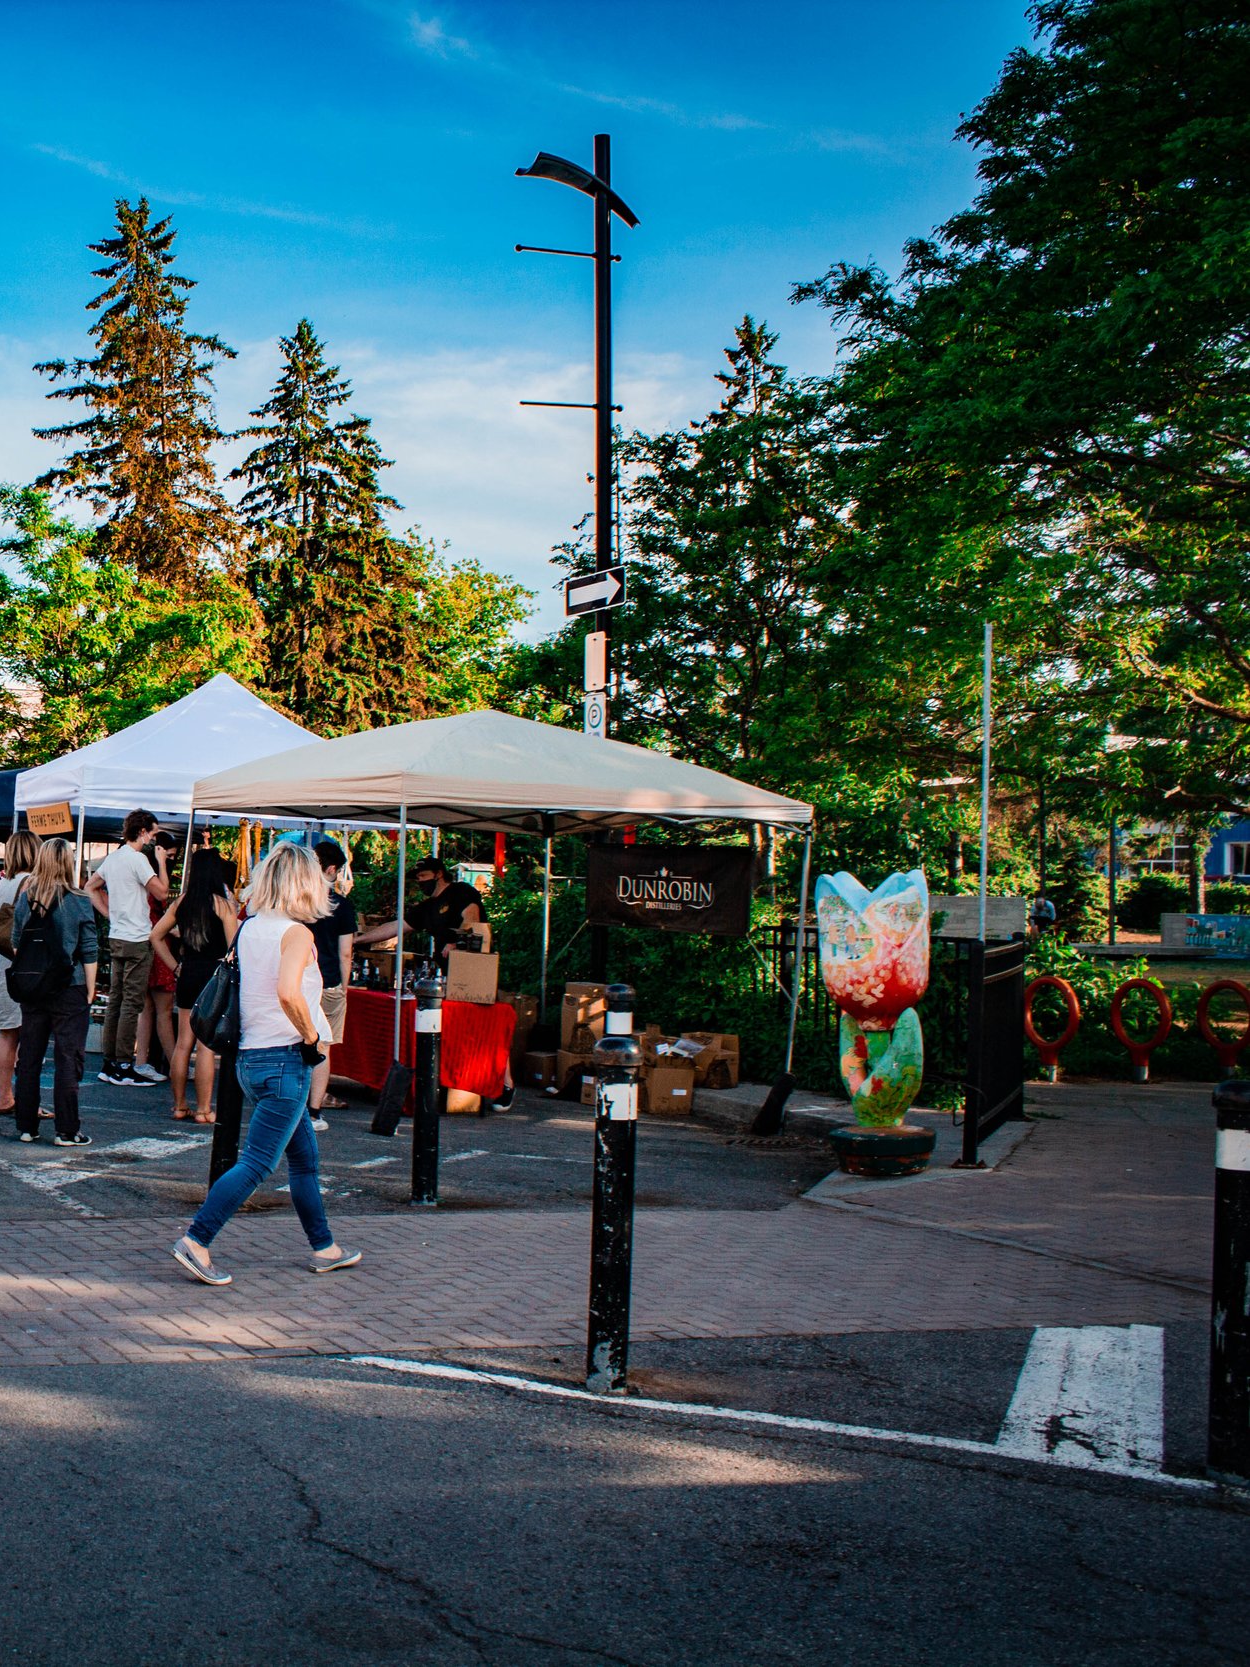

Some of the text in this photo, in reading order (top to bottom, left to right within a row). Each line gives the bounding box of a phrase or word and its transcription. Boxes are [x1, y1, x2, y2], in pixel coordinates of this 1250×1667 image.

[31, 813, 47, 828] FERME
[618, 875, 713, 903] DUNROBIN
[645, 901, 682, 911] DISTILLERIES
